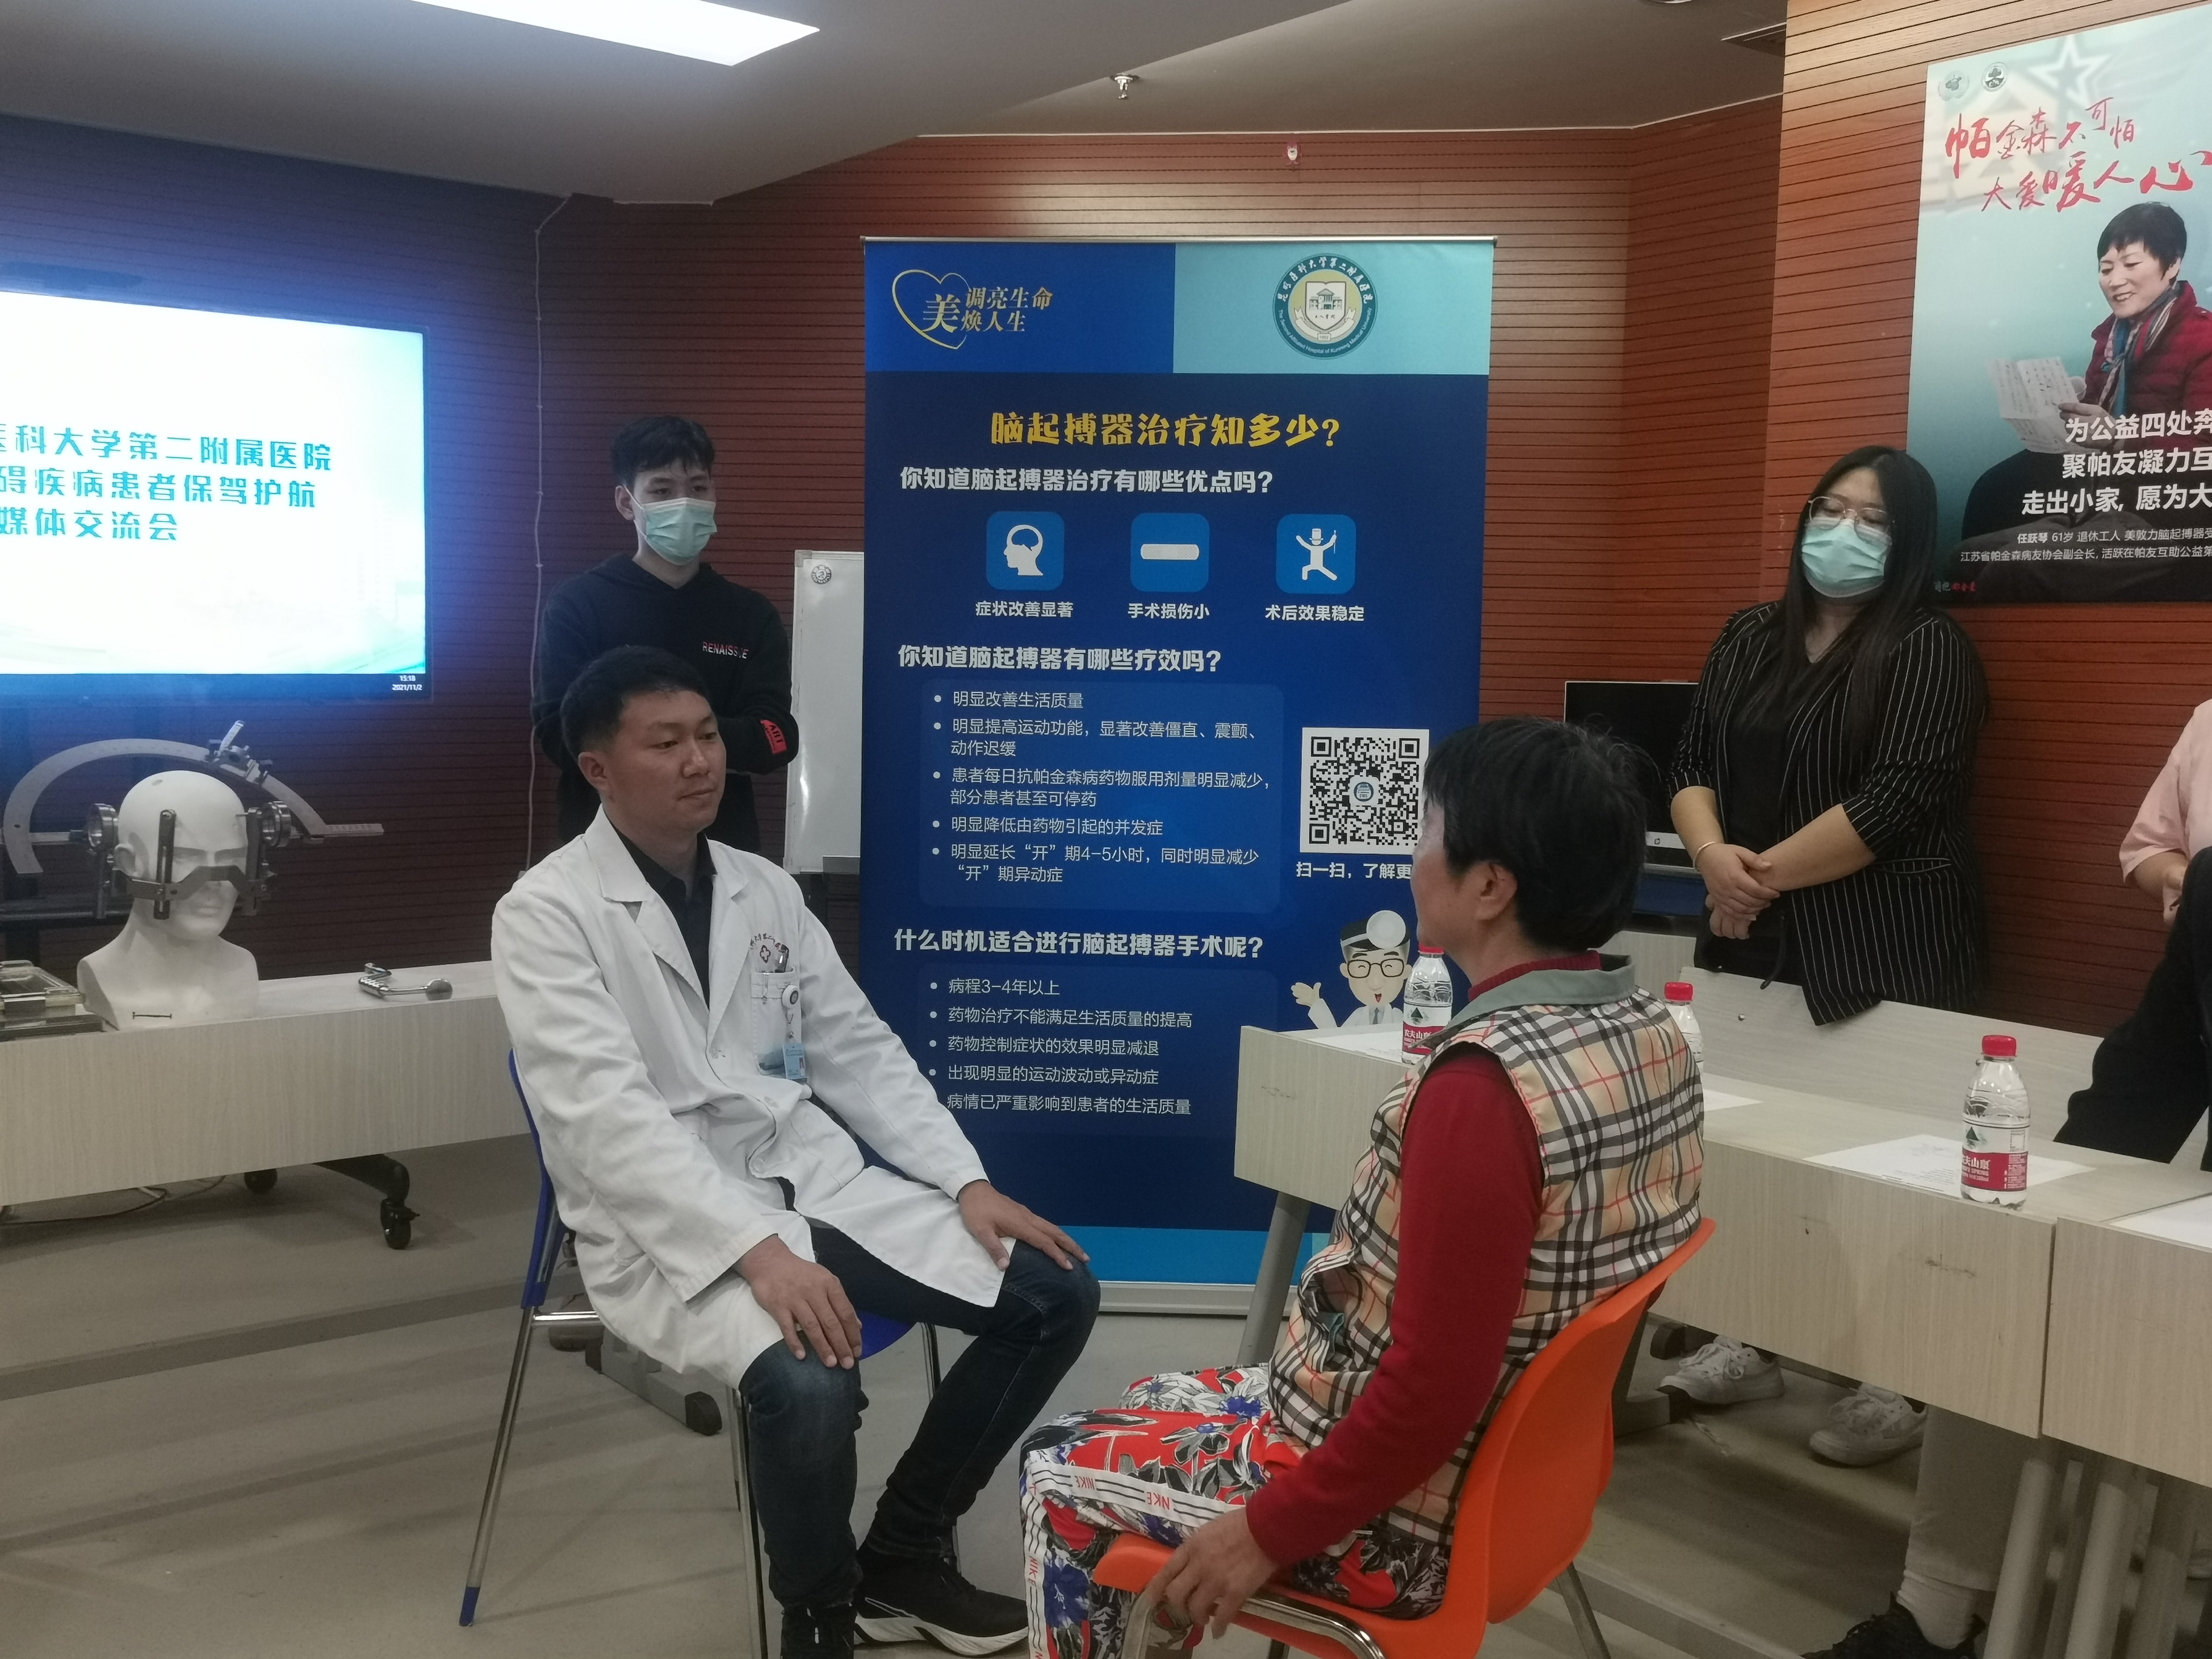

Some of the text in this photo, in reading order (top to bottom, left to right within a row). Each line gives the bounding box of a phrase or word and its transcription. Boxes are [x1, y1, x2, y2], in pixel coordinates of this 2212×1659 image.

[965, 287, 1053, 310] 调亮生命
[921, 294, 960, 333] 美
[960, 310, 1025, 332] 焕人生
[2065, 407, 2212, 443] 为公益四处奔
[0, 424, 331, 471] 科大学第二附属医院
[2062, 446, 2212, 478] 聚帕友凝力互
[2051, 531, 2074, 543] 61岁
[2076, 529, 2120, 543] 退休工人
[976, 600, 1074, 618] 症状改善显著
[1128, 603, 1210, 621] 手术损伤小
[1265, 605, 1365, 623] 术后效果稳定
[953, 691, 1084, 709] 明显改善生活质量
[951, 740, 1016, 757] 动作迟缓
[950, 789, 1097, 807] 部分患者甚至可停药
[951, 817, 1164, 836] 明显降低由药物引起的并发症
[948, 1007, 1193, 1028] 药物治疗不能满足生活质量的提高
[948, 1036, 1159, 1056] 药物控制症状的效果明显减退
[948, 1065, 1159, 1085] 出现明显的运动波动或异动症
[947, 1093, 1191, 1115] 病情已严重影响到患者的生活质量
